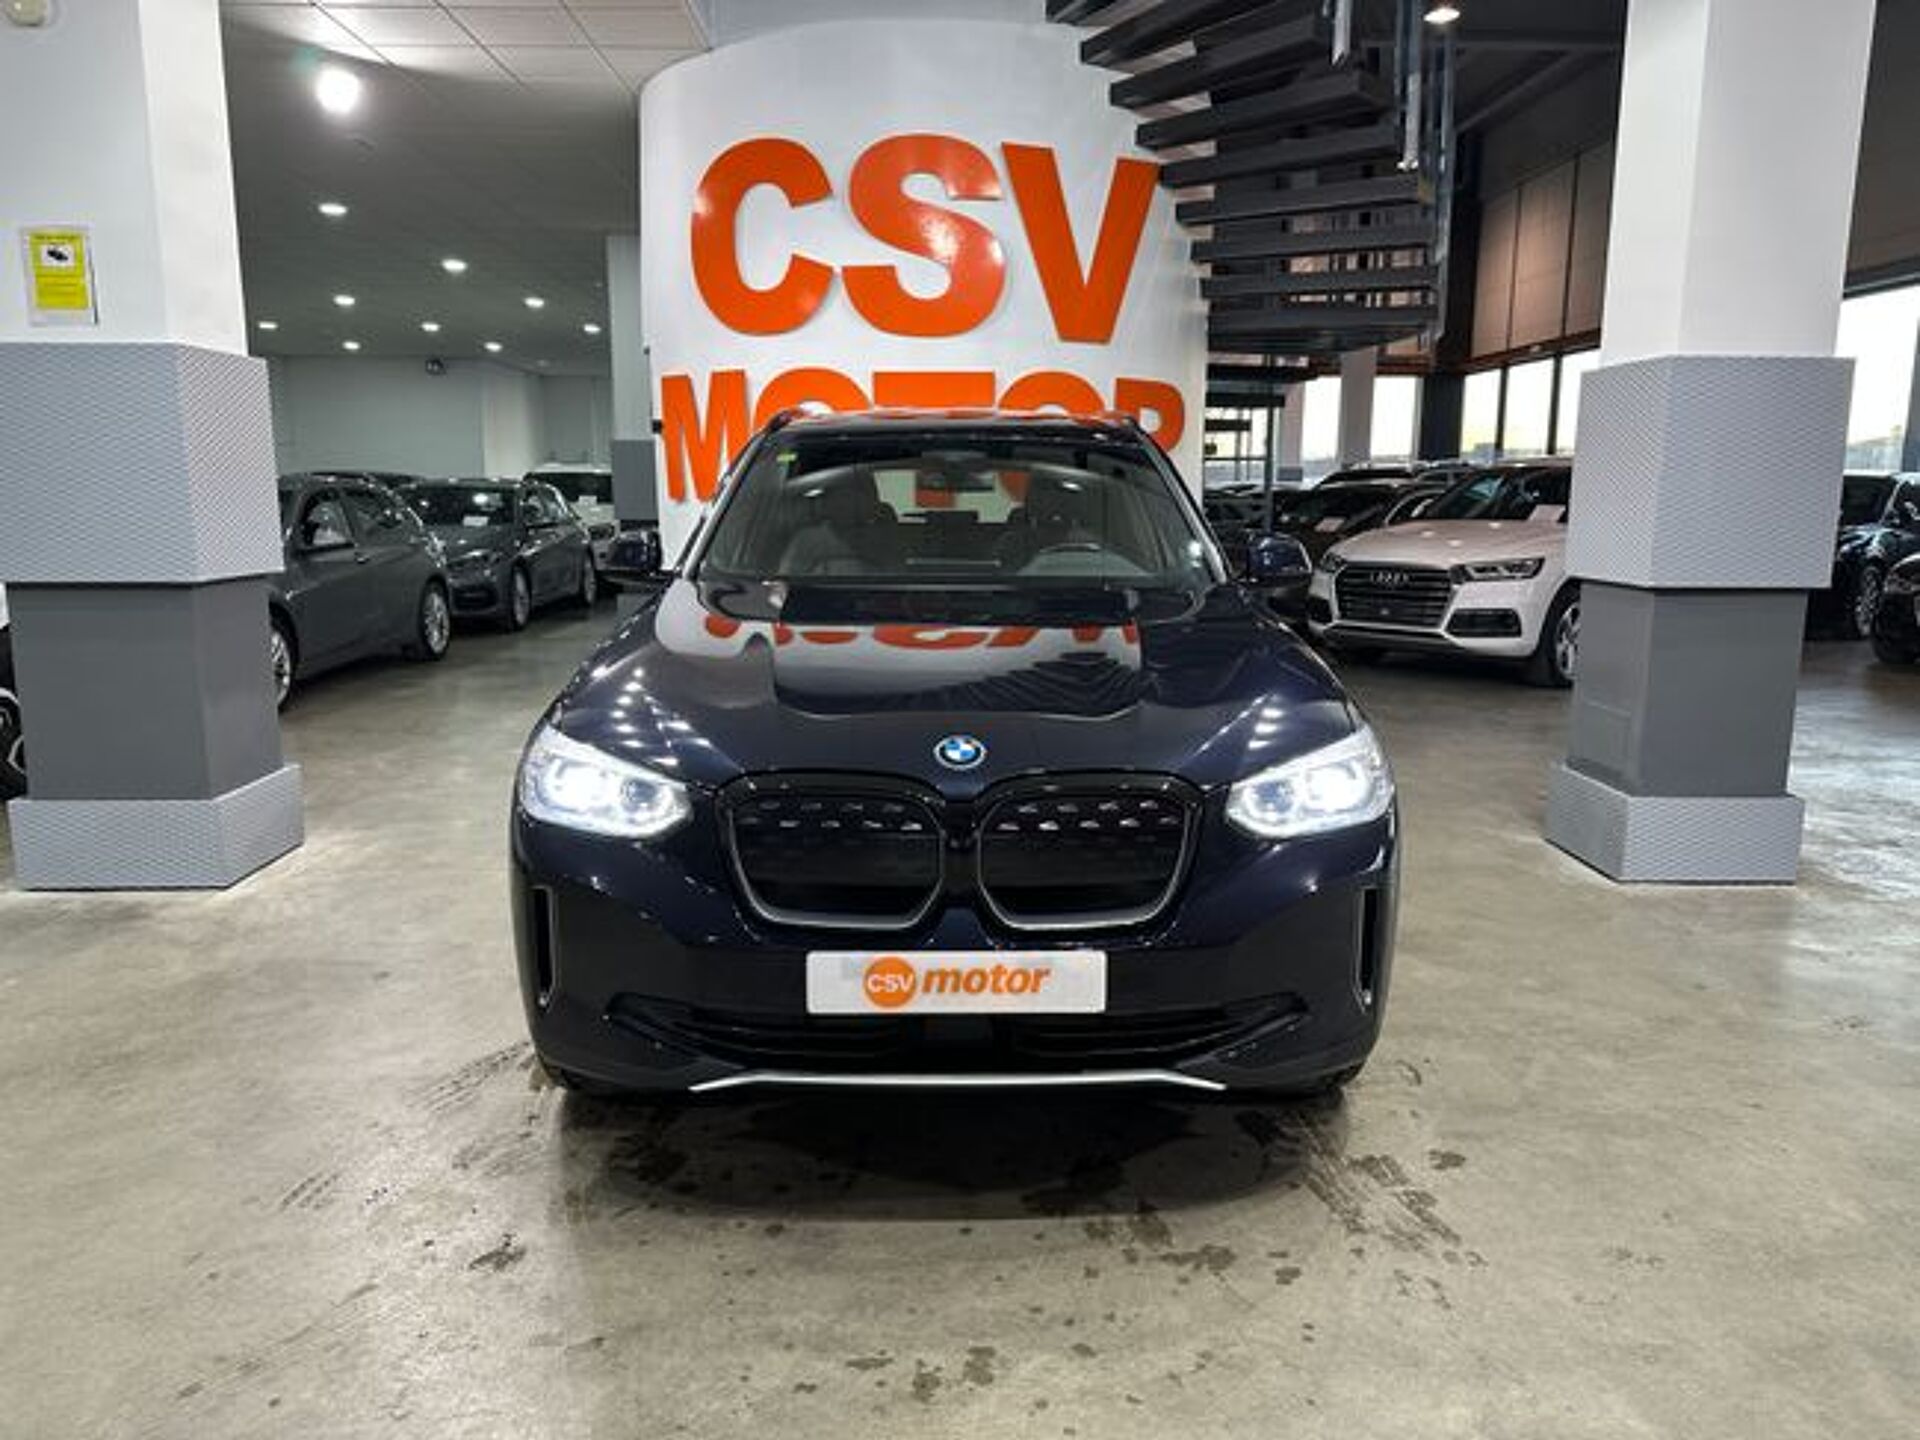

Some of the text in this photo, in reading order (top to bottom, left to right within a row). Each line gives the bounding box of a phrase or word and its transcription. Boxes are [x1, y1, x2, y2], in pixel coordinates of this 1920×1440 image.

[690, 134, 1158, 343] CSV
[661, 367, 1185, 502] MTR
[866, 964, 1051, 994] CSV motor
